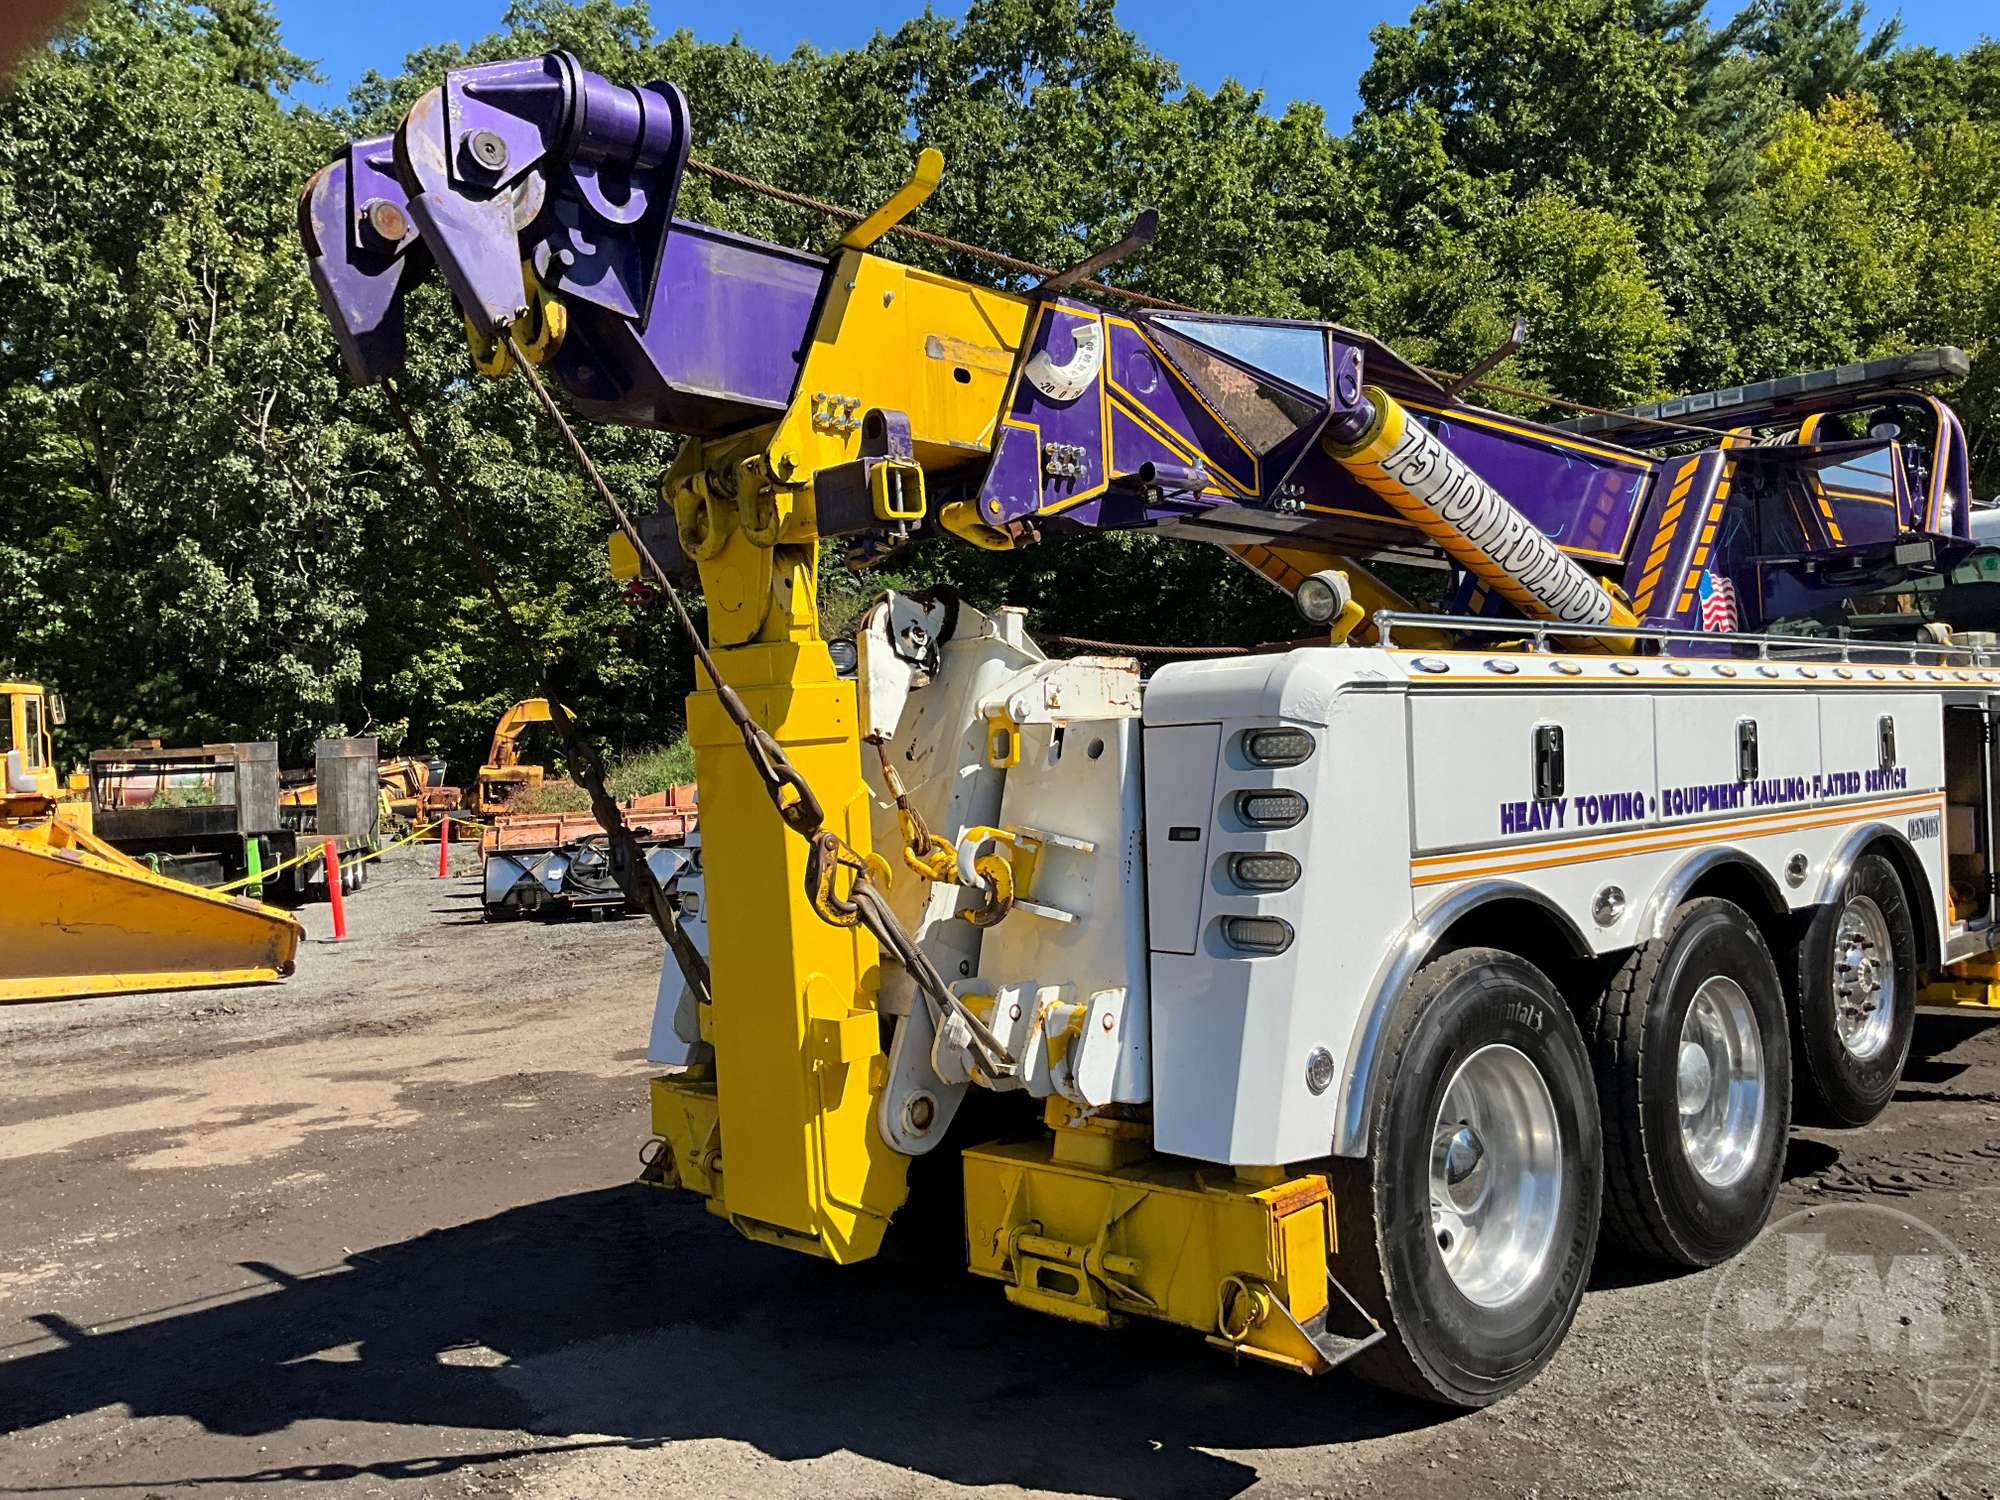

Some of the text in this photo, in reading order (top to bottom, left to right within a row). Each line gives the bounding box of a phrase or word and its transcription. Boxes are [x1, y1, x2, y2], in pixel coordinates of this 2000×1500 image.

[1040, 381, 1055, 394] -20
[1378, 419, 1612, 627] 75 TON ROTATOR
[1500, 767, 1908, 835] HEAVY TOWING EQUIPMENT HAULING FLATBED SERVICE
